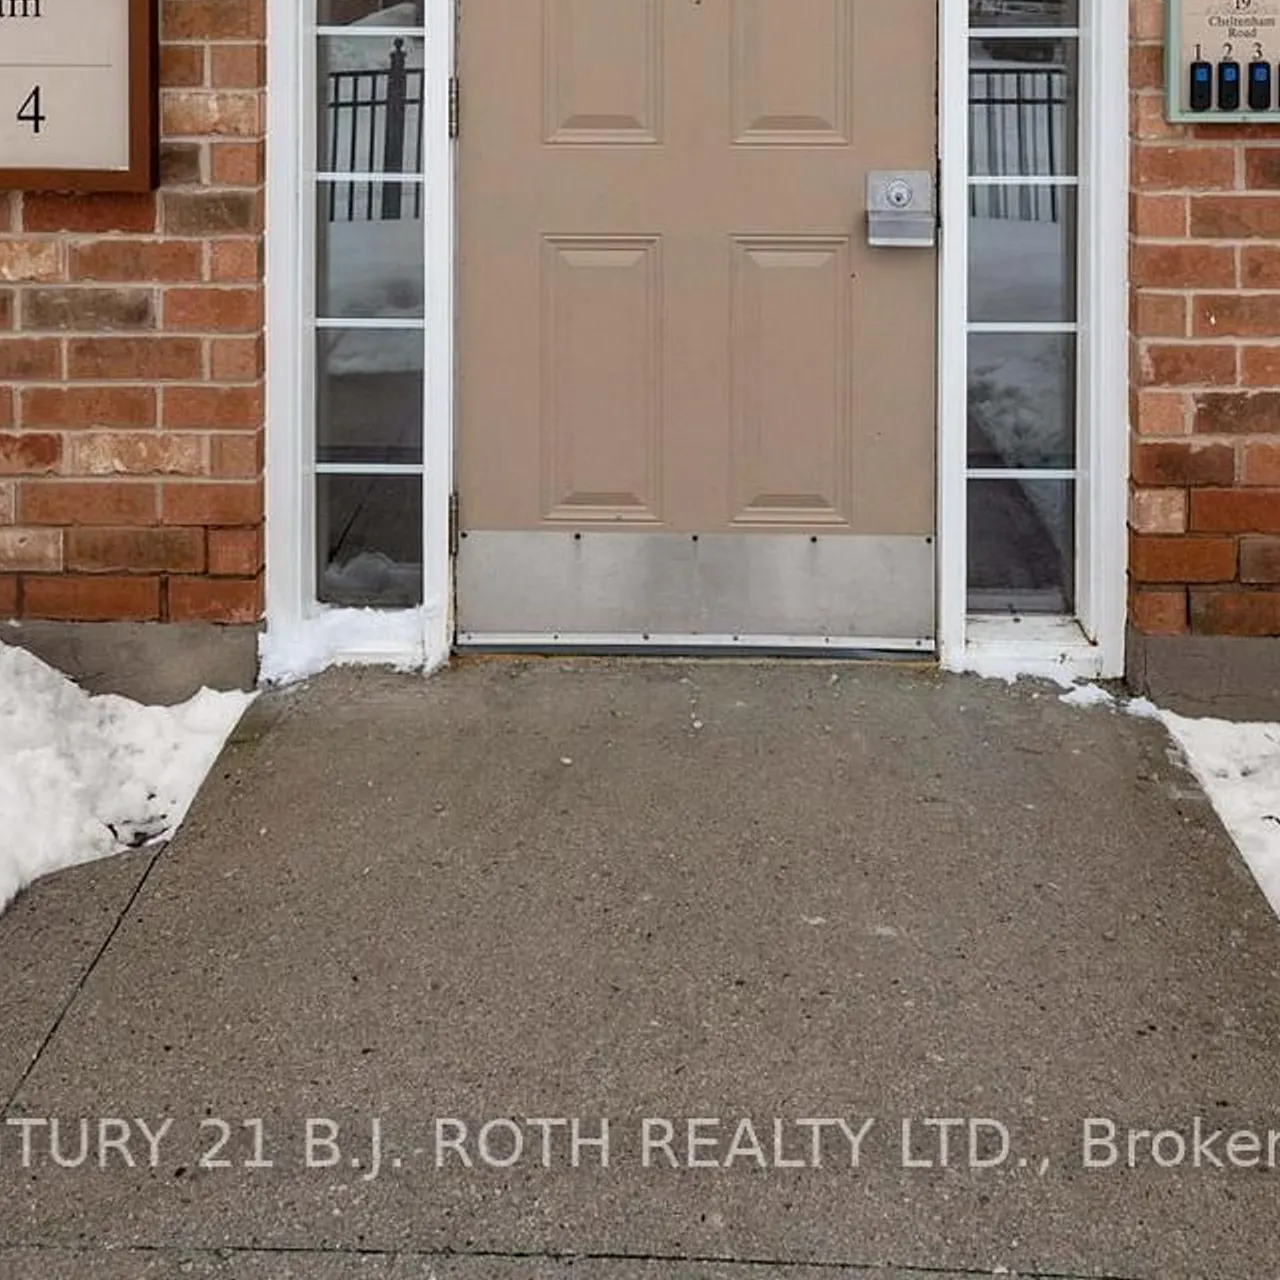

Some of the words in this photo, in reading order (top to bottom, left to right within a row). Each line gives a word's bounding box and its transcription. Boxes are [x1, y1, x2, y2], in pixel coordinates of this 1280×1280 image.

[1194, 43, 1202, 61] 1
[1222, 42, 1233, 61] 2
[1251, 42, 1263, 61] 3
[16, 85, 46, 134] 4
